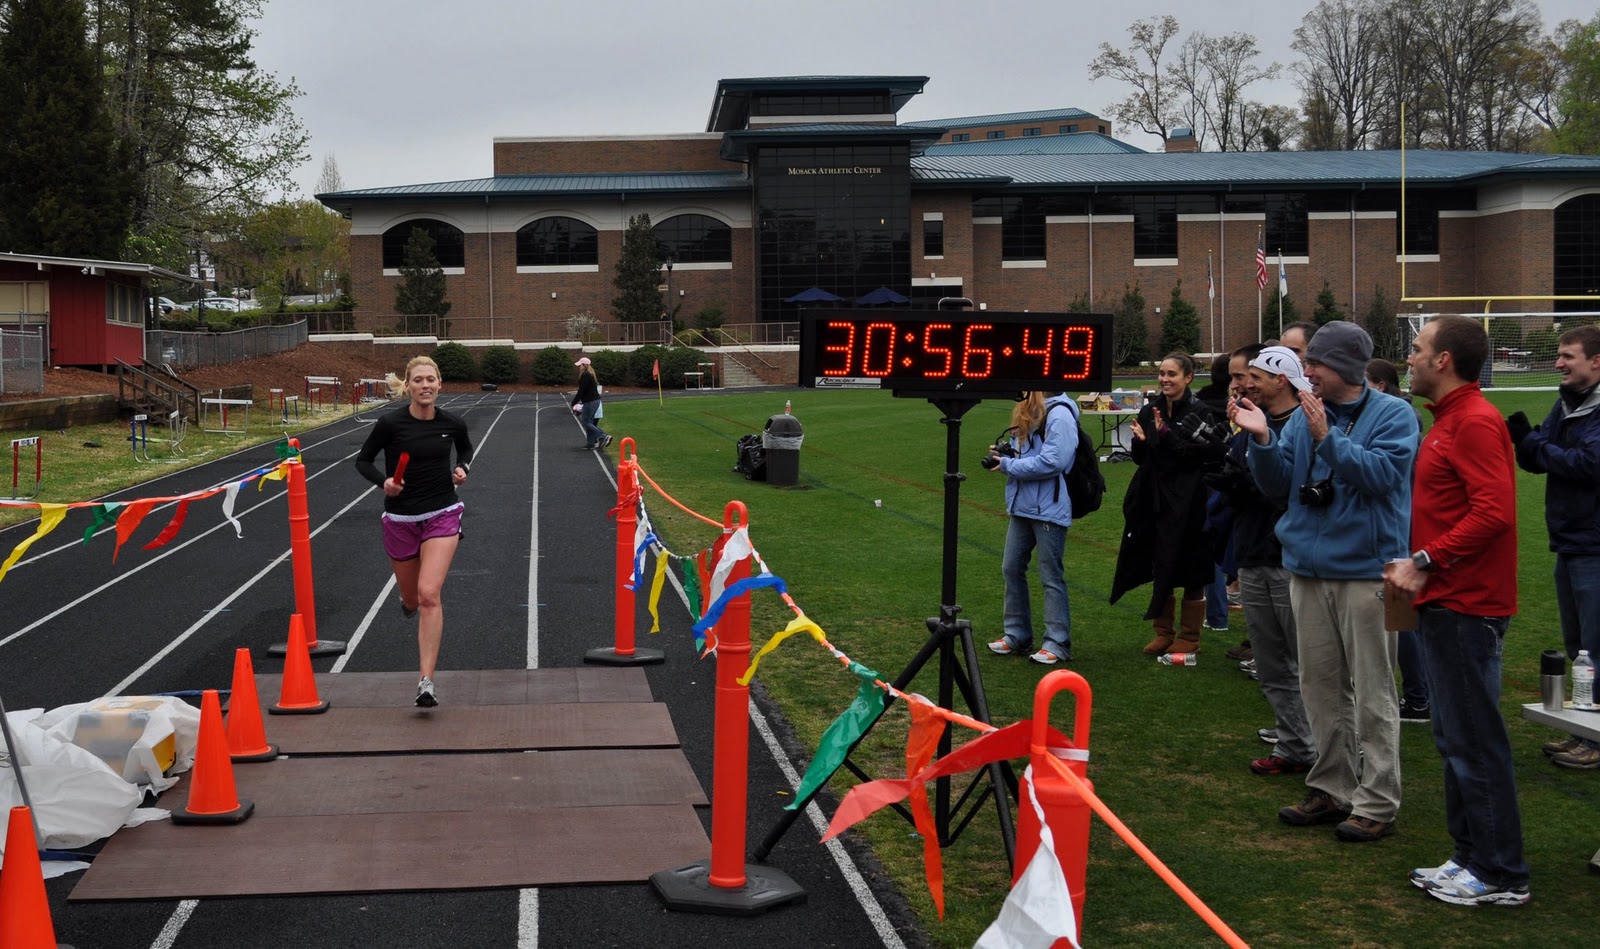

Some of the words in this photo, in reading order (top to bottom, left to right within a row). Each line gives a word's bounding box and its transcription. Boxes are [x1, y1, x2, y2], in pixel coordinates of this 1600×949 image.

[788, 167, 817, 175] MOSACK
[818, 167, 853, 175] ATHLETIC
[853, 166, 882, 174] CENTER
